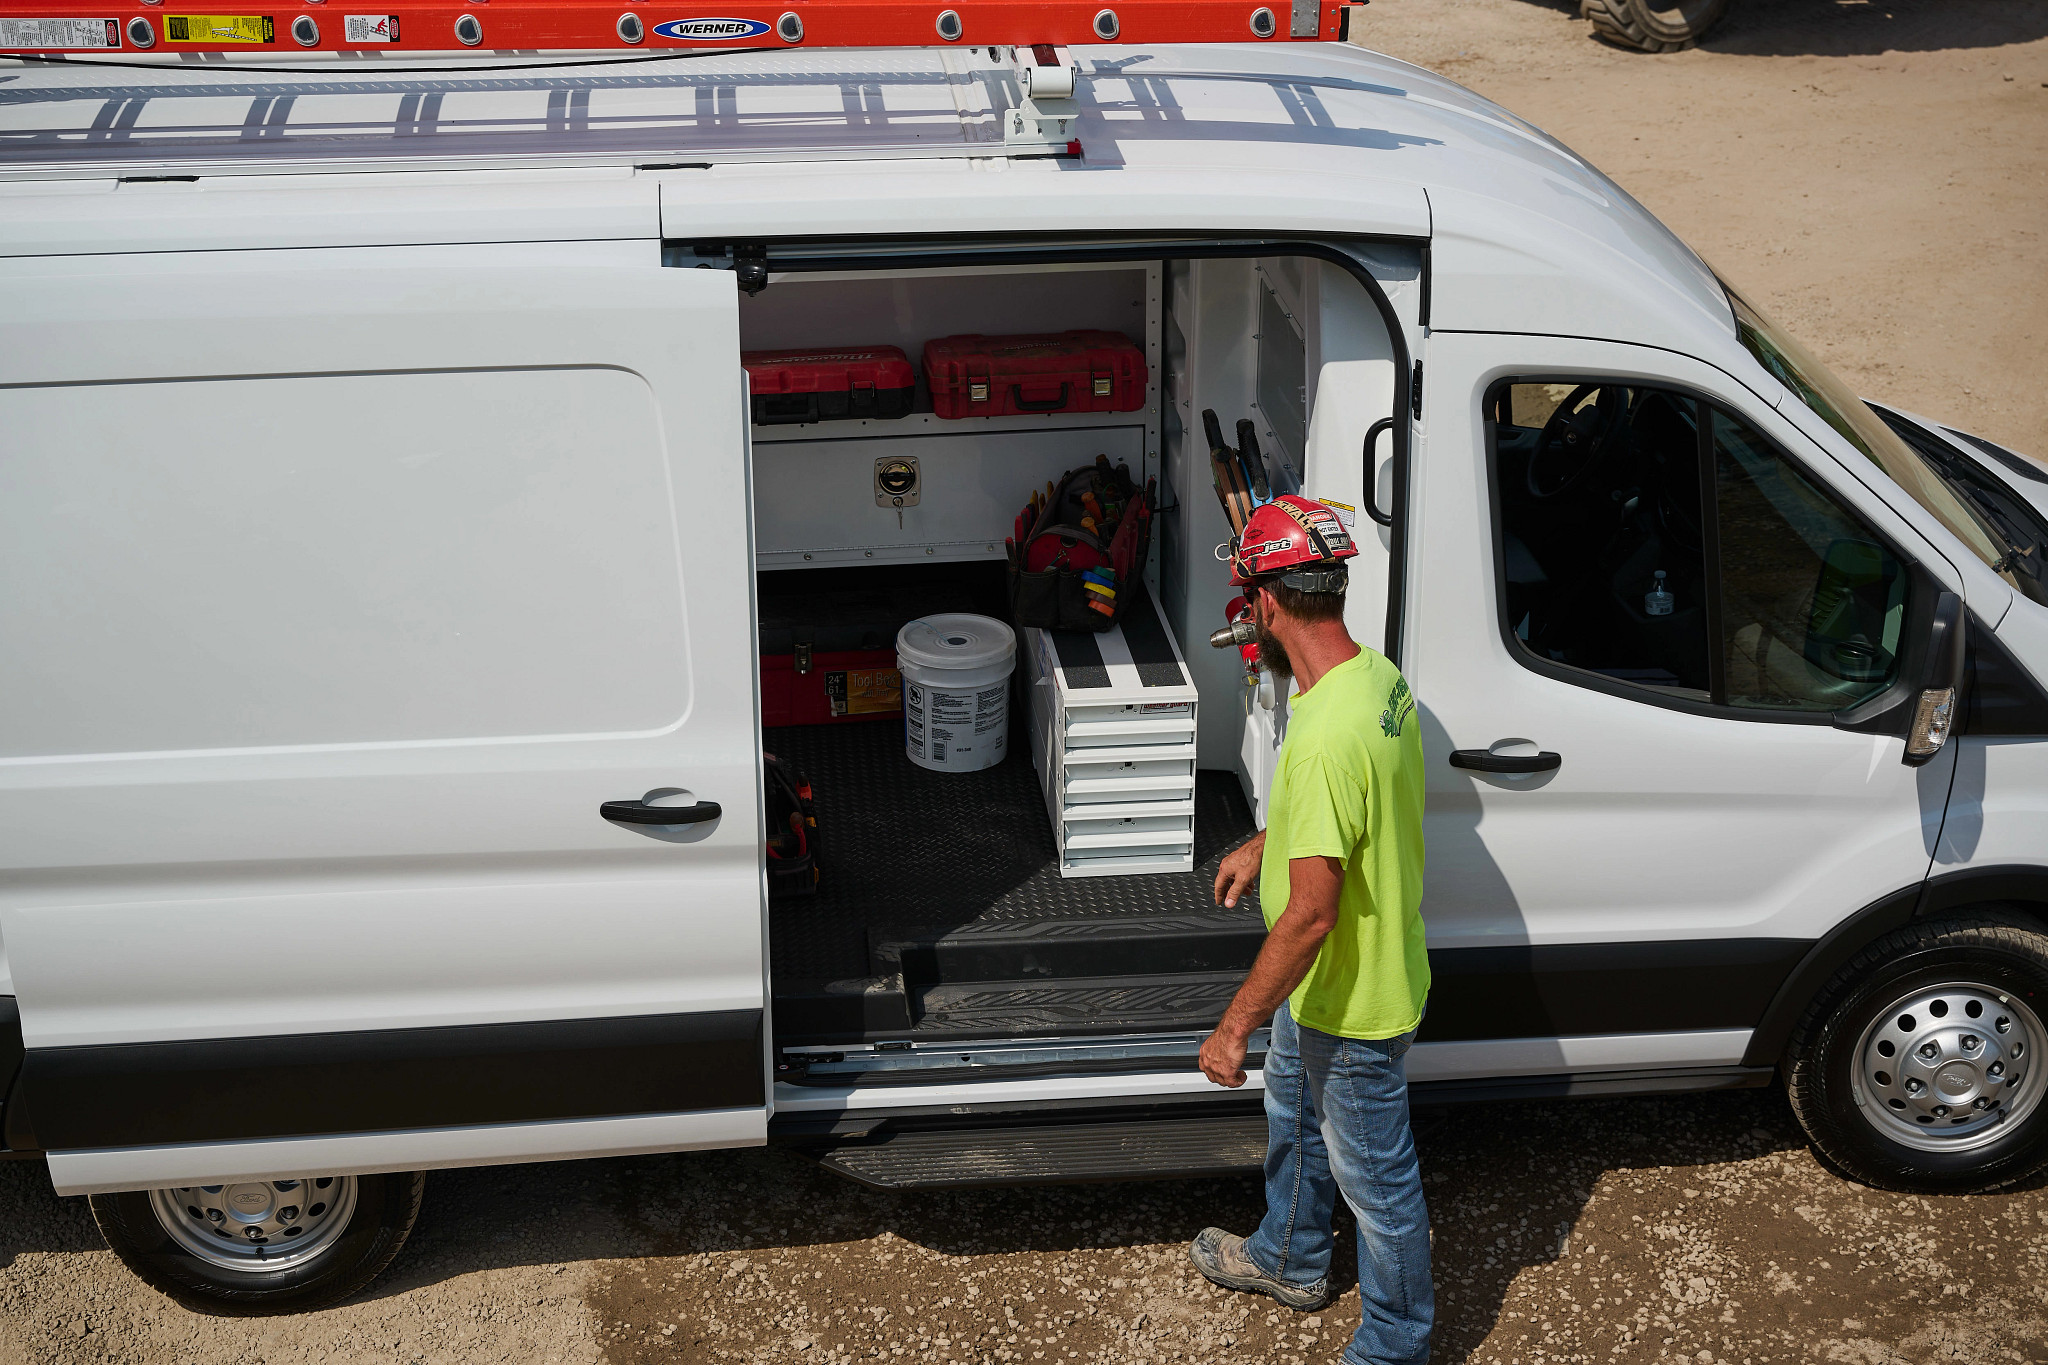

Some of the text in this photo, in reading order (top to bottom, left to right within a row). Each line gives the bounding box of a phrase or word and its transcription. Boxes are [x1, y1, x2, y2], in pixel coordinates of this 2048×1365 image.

[679, 23, 746, 34] WERNER
[1240, 540, 1290, 558] ynojet
[852, 671, 896, 688] Tool Box
[828, 685, 839, 694] 61
